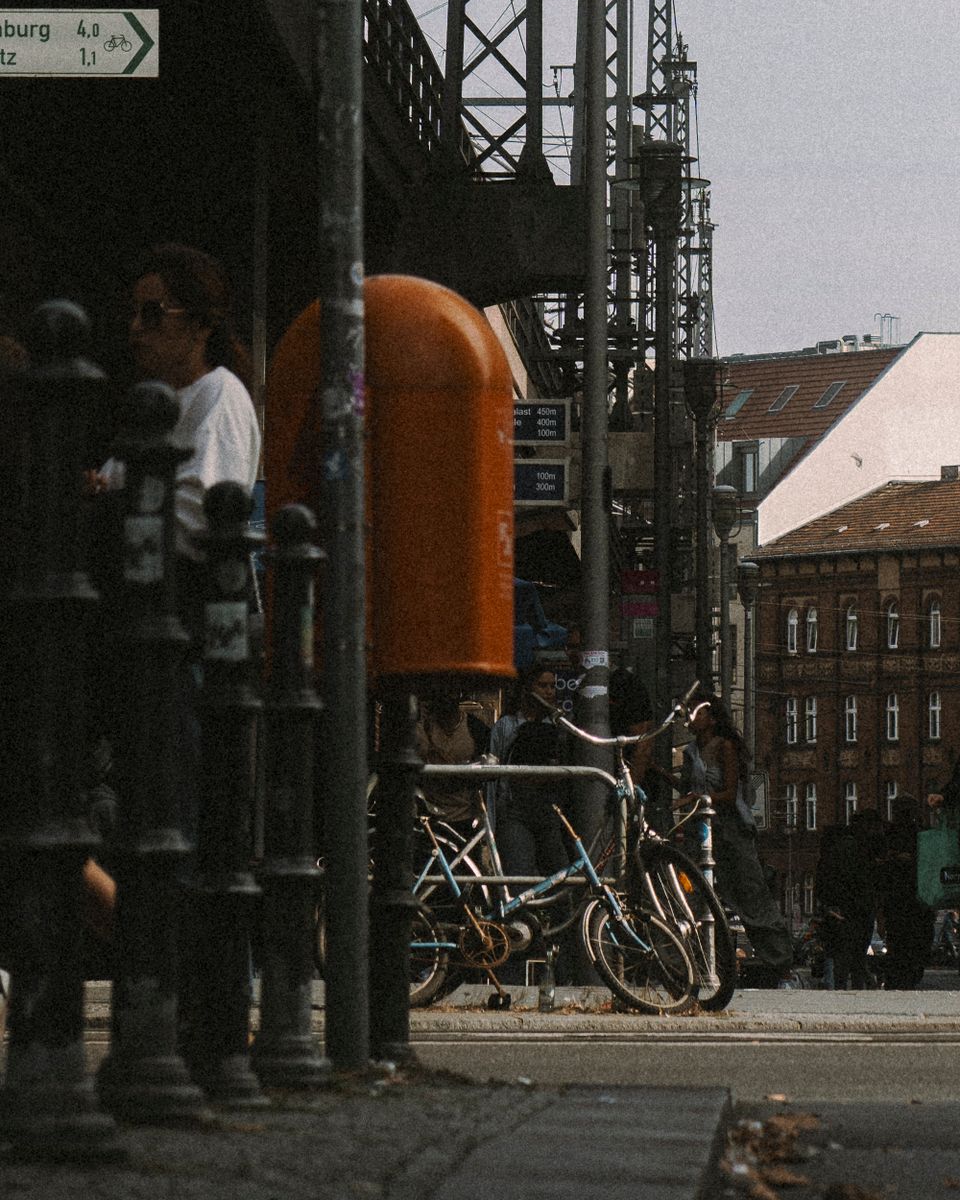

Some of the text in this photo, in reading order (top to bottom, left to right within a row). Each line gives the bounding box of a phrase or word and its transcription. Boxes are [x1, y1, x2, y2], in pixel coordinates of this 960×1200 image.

[77, 19, 99, 39] 4,0
[79, 47, 96, 67] 1,1
[536, 407, 557, 416] 450m
[536, 418, 557, 426] 400m
[537, 428, 557, 437] 100m
[536, 471, 556, 480] 100m
[535, 482, 556, 491] 300m
